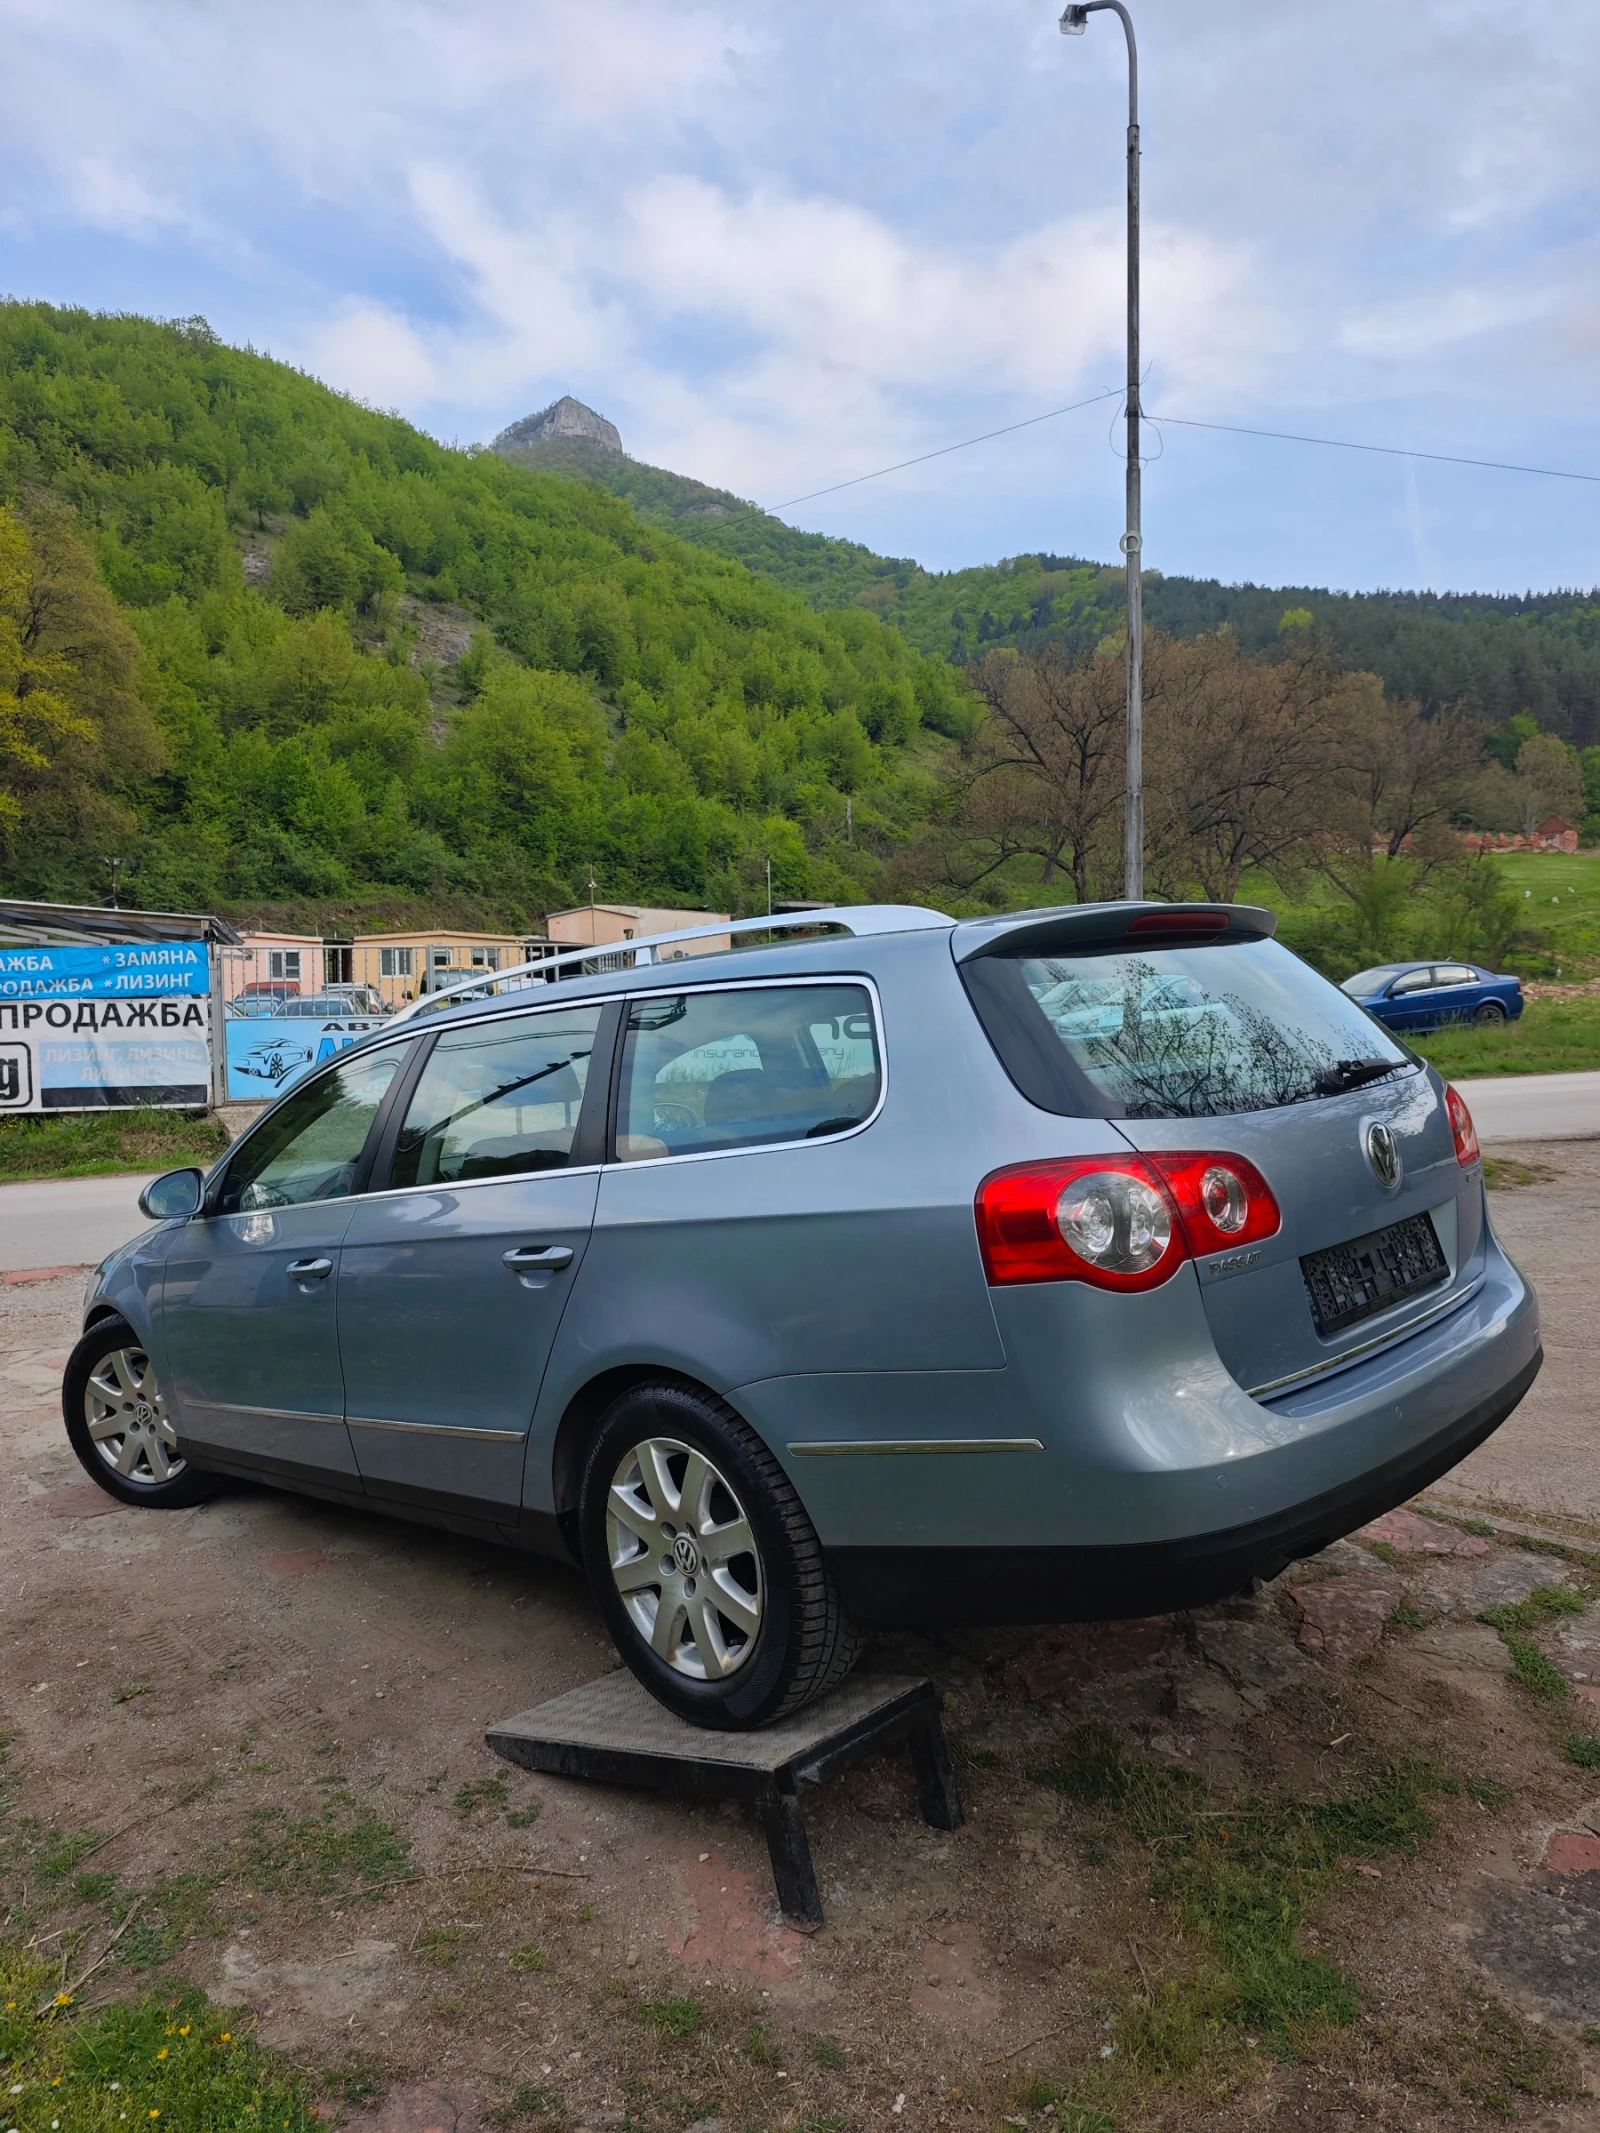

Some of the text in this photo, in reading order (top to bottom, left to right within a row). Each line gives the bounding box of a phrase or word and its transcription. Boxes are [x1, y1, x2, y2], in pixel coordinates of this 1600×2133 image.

[115, 949, 198, 967] ЗАМЯНА
[0, 972, 194, 997] ОДАЖБА ЛИЗИНГ
[0, 1002, 205, 1033] ПРОДАЖБА
[1209, 1250, 1261, 1275] PASSAT
